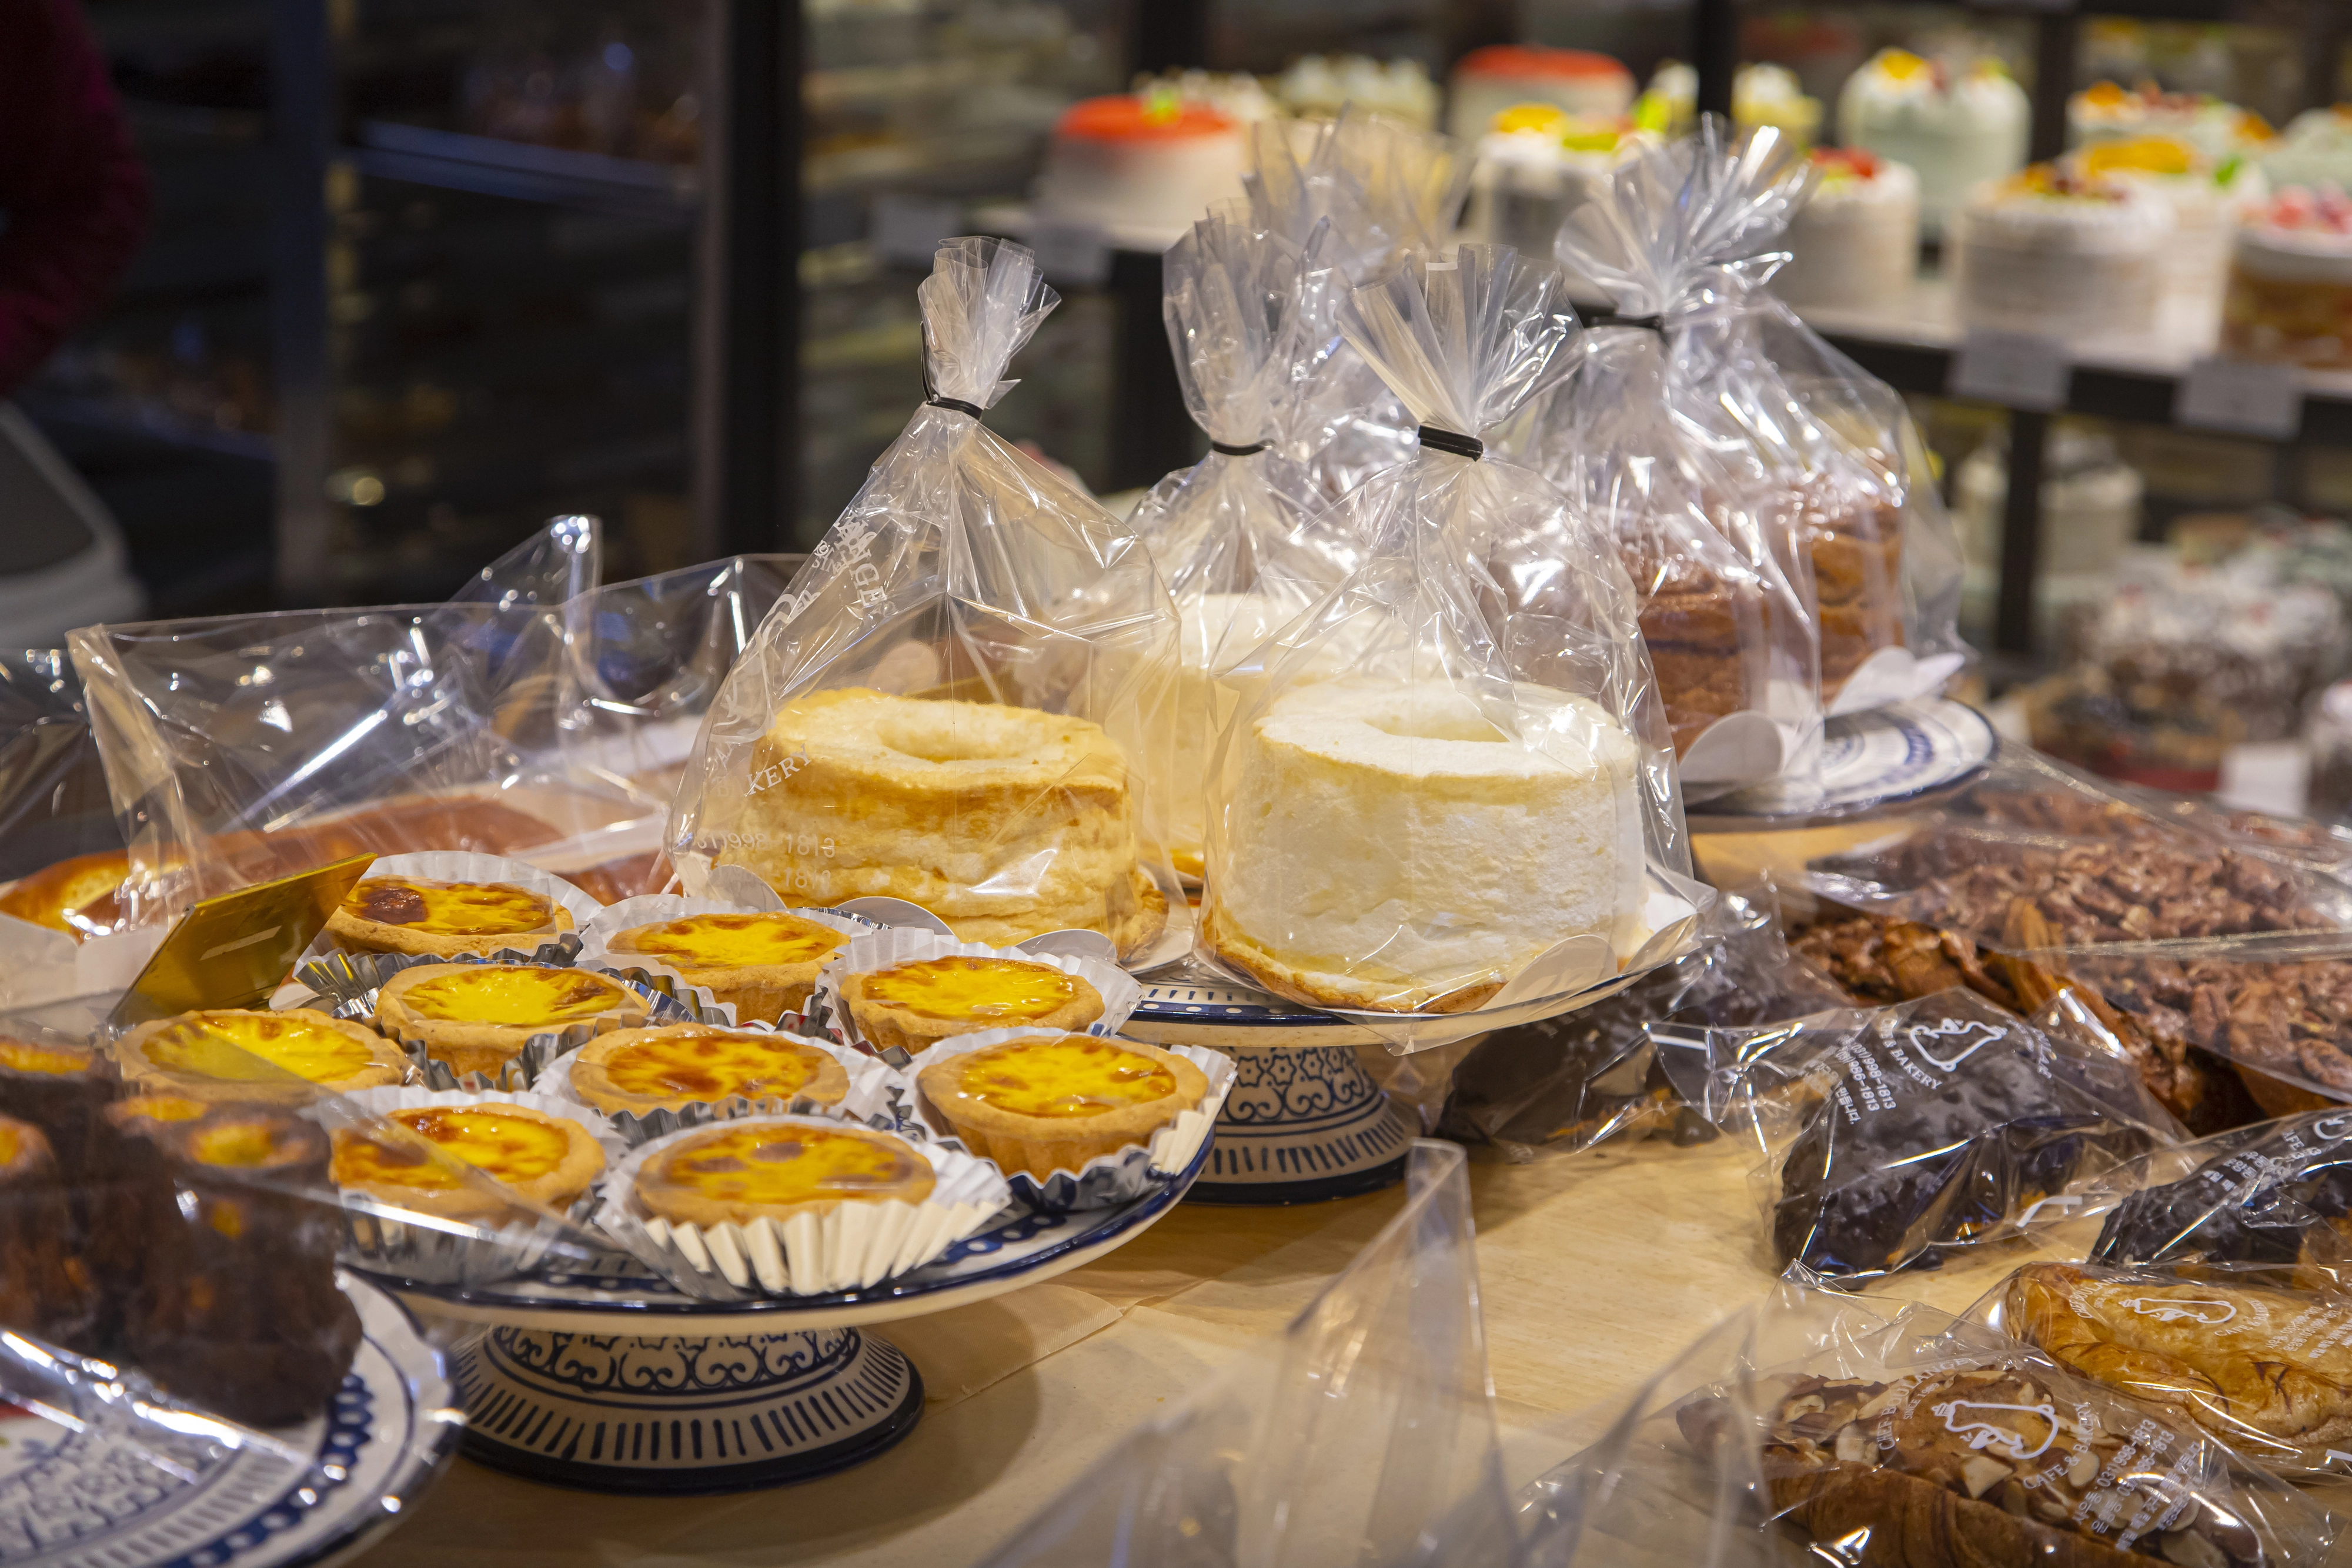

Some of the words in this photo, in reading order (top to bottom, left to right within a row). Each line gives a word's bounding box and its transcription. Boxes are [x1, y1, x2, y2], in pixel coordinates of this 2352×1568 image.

[1890, 1047, 1943, 1090] BAKERY
[1880, 1358, 1970, 1416] BOULANGE
[1903, 1399, 1922, 1420] SINCE
[2023, 1463, 2070, 1490] CAFE
